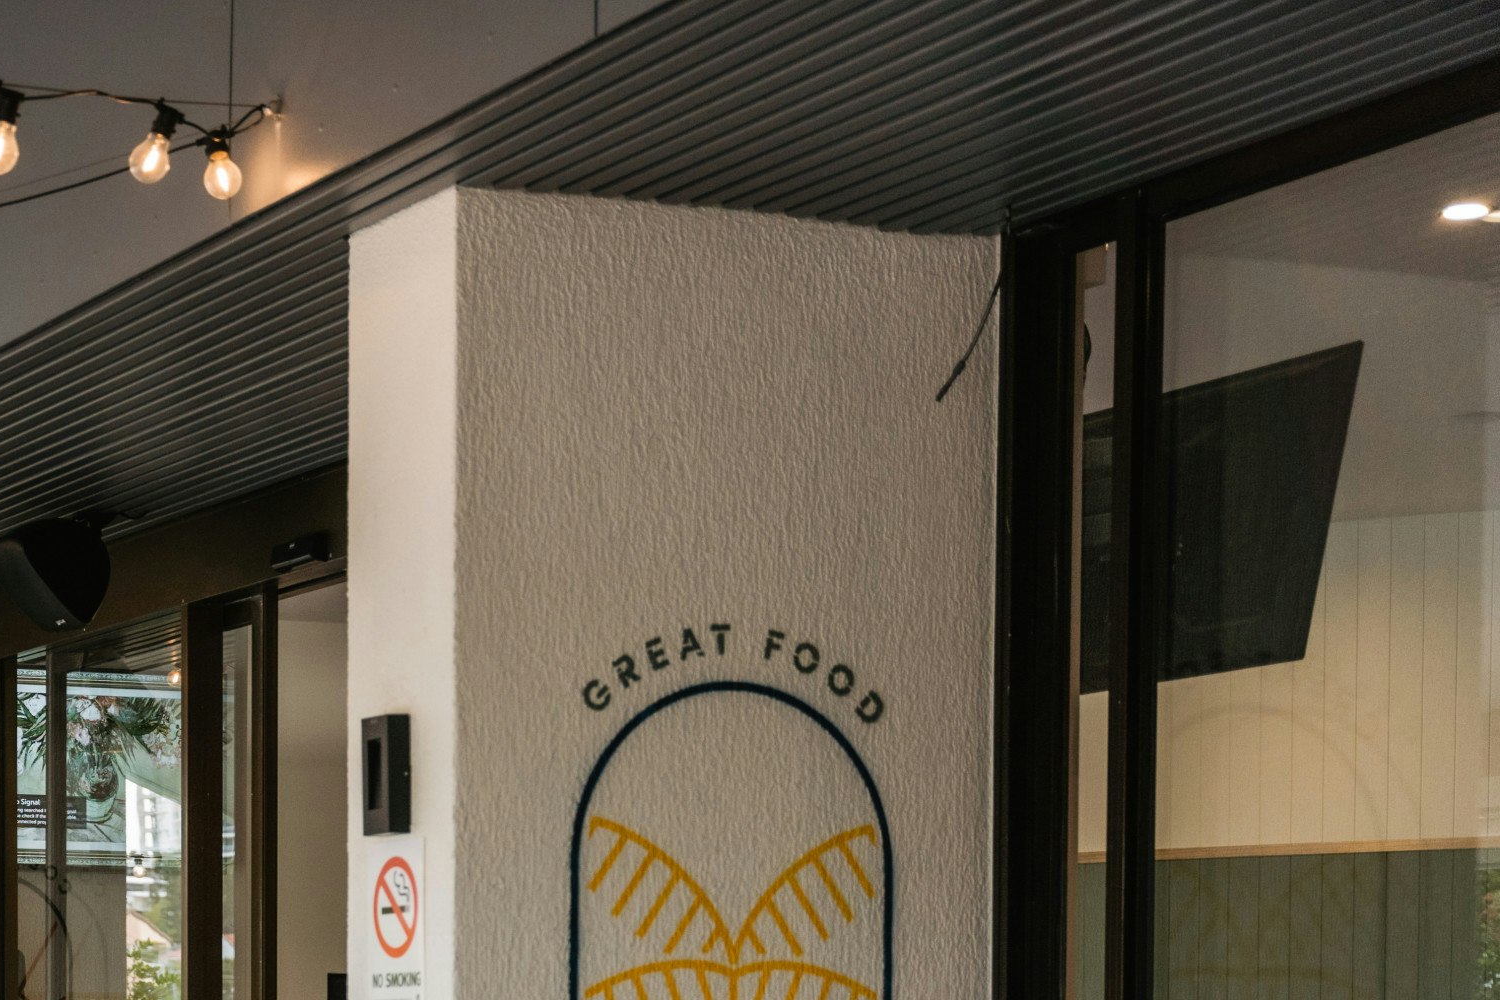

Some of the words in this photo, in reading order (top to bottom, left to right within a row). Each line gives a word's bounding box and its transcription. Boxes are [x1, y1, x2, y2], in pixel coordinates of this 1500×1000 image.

[582, 623, 731, 711] GREAT
[764, 629, 885, 724] FOOD
[20, 798, 41, 807] Signal
[372, 973, 384, 988] NO
[386, 971, 421, 988] SMOKING
